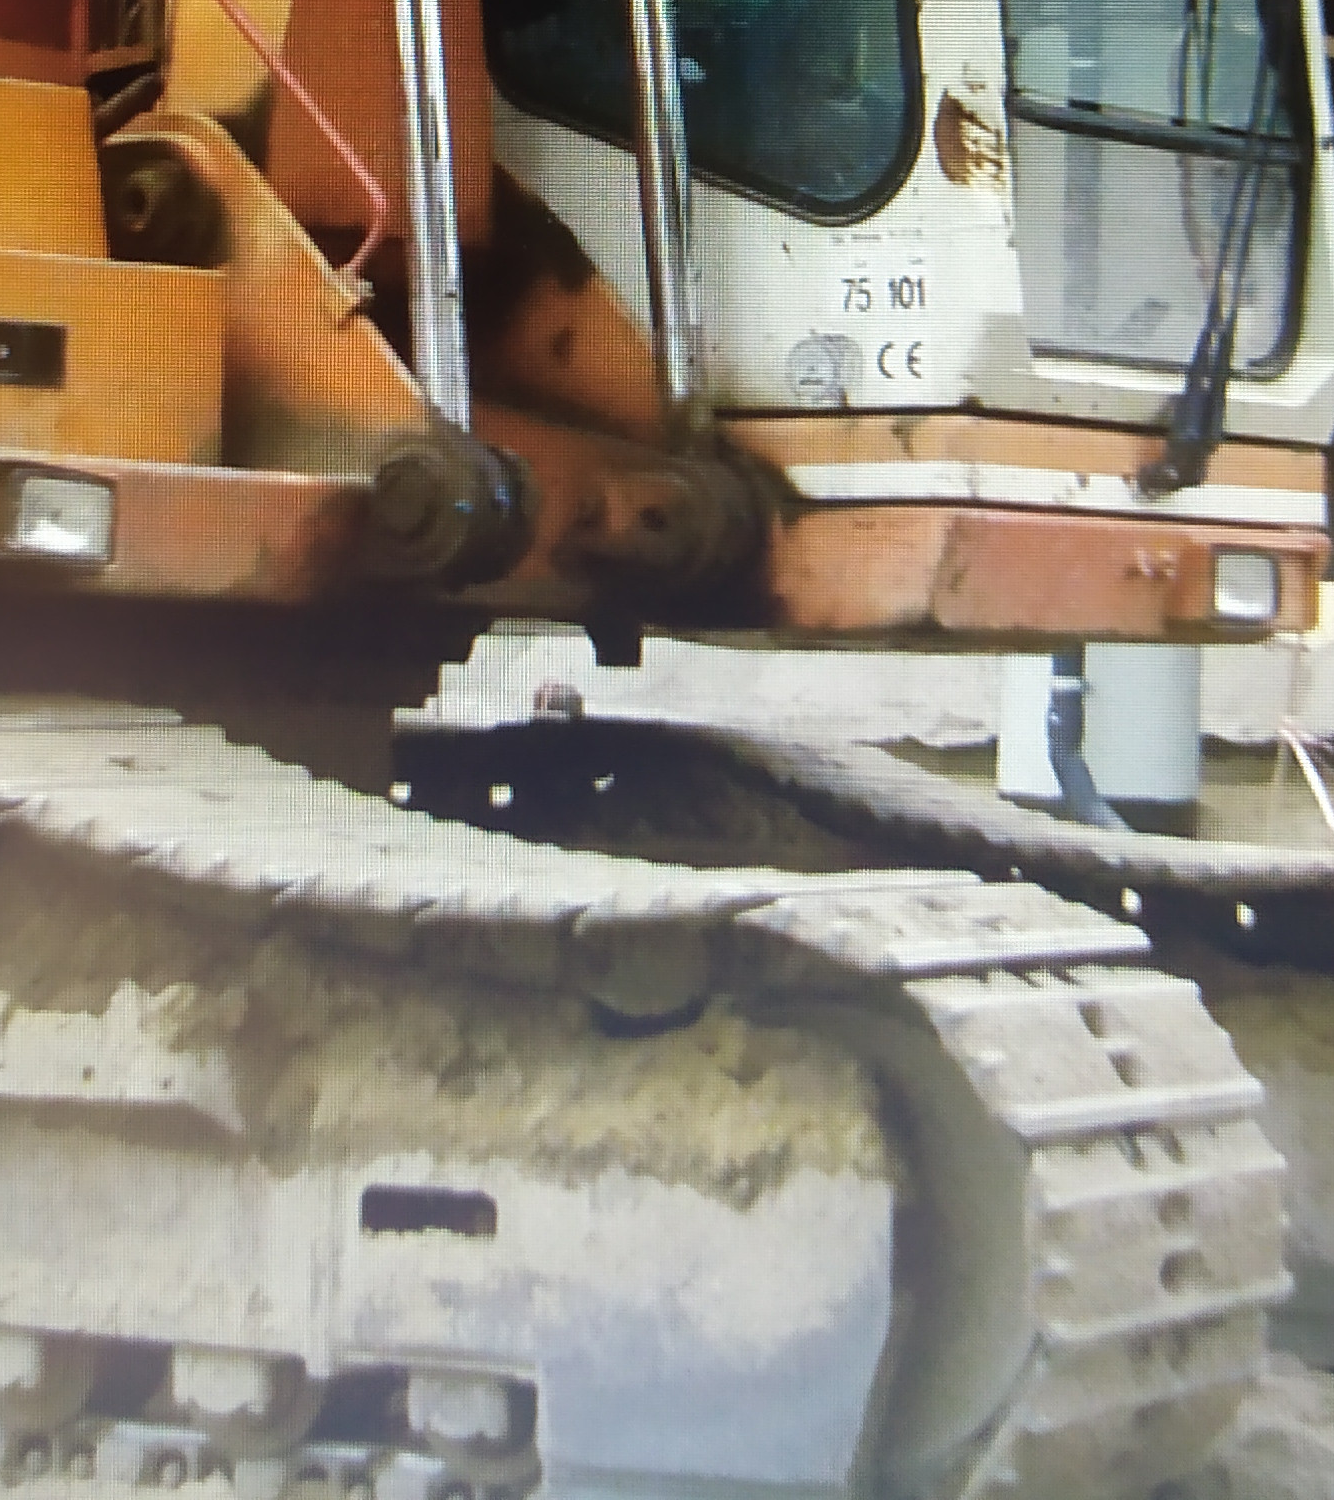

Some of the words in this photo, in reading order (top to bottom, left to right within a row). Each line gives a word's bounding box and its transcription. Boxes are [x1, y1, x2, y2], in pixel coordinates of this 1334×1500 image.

[841, 277, 872, 312] 75
[888, 275, 926, 310] 101
[876, 340, 923, 380] CE
